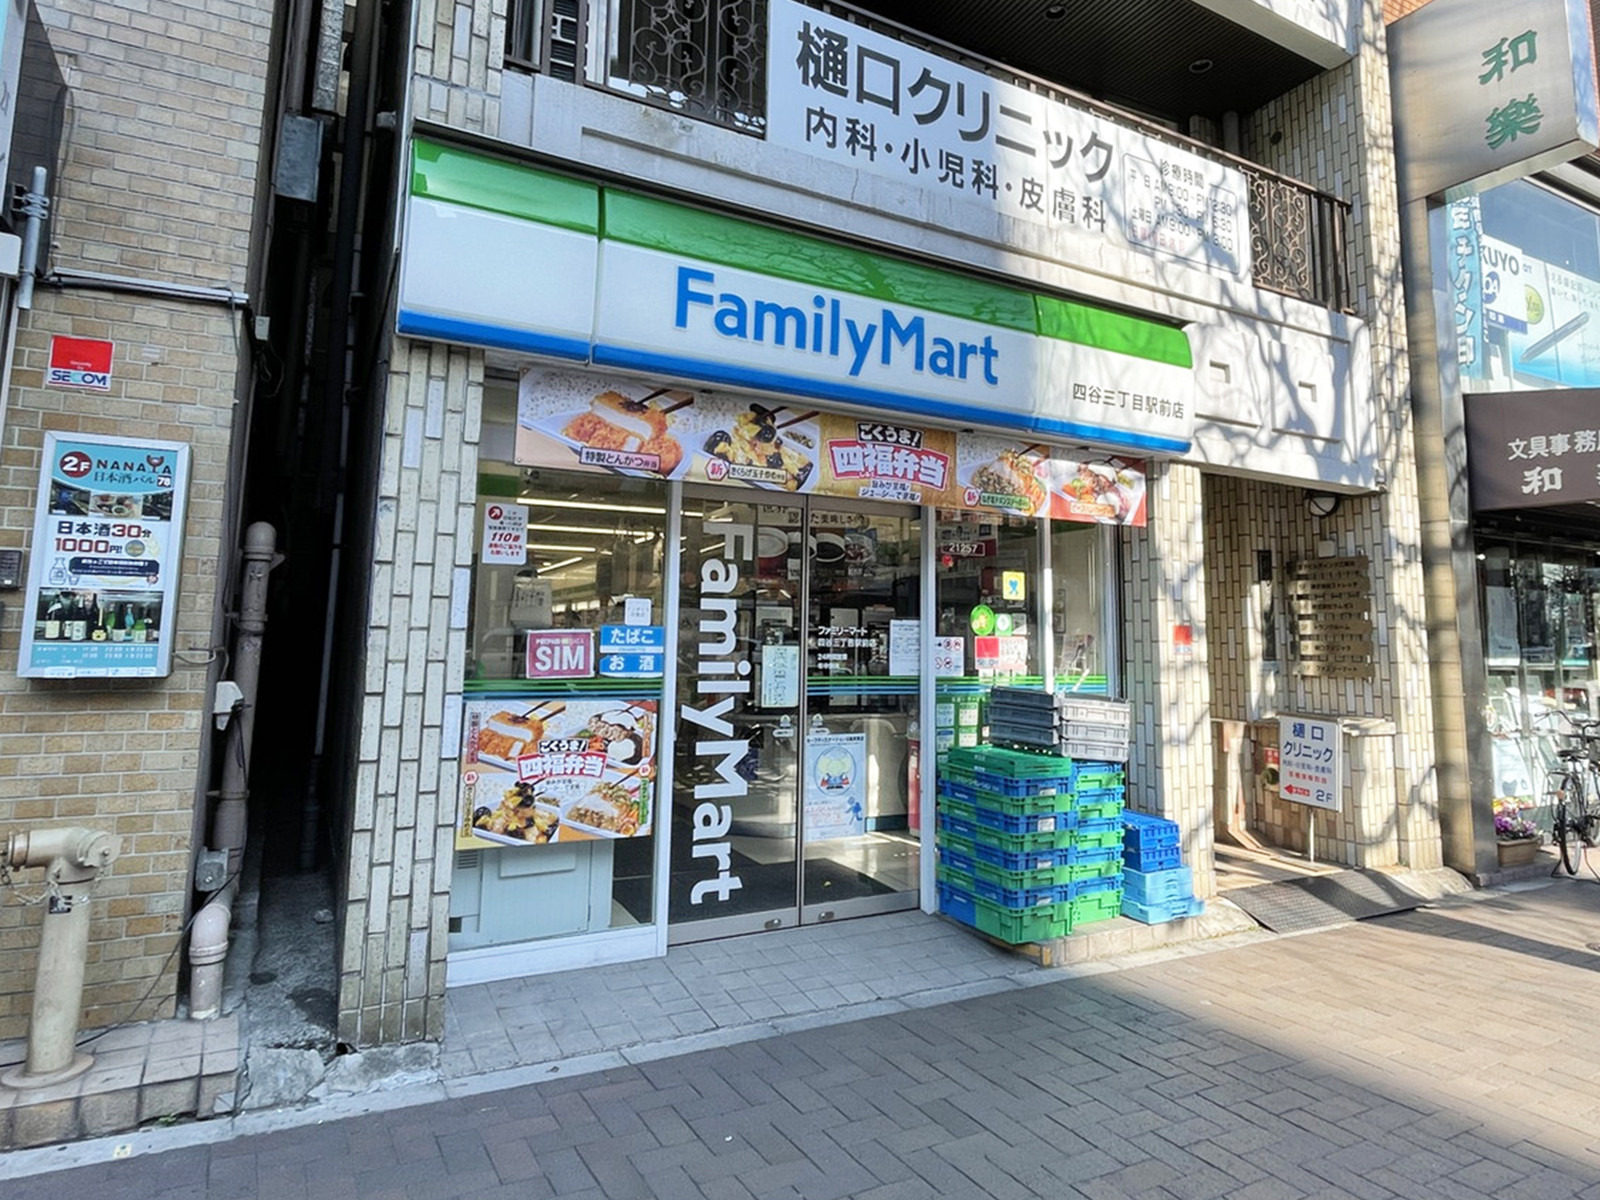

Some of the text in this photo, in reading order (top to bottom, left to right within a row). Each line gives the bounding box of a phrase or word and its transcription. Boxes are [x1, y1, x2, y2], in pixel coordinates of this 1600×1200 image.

[795, 19, 1115, 184] 樋口クリニック
[805, 107, 1108, 233] 内科・小児科・皮膚科
[675, 265, 999, 386] FamilyMart
[51, 370, 107, 386] SECOM
[1072, 382, 1185, 420] 四谷三丁目駅前店
[1507, 429, 1600, 460] 文具事務
[62, 456, 92, 472] 2F
[585, 450, 658, 469] 特製とんかつ弁当
[711, 461, 723, 476] 新
[831, 443, 944, 487] 四福弁当
[1521, 466, 1563, 496] 和
[57, 521, 152, 539] 日本酒30分
[610, 628, 655, 644] たばこ
[817, 625, 868, 637] ファミリーマート
[535, 645, 585, 671] SIM
[681, 522, 755, 905] FamilyMart
[1292, 722, 1325, 741] 樋口
[1283, 740, 1334, 763] クリニック
[1315, 789, 1334, 803] 2F
